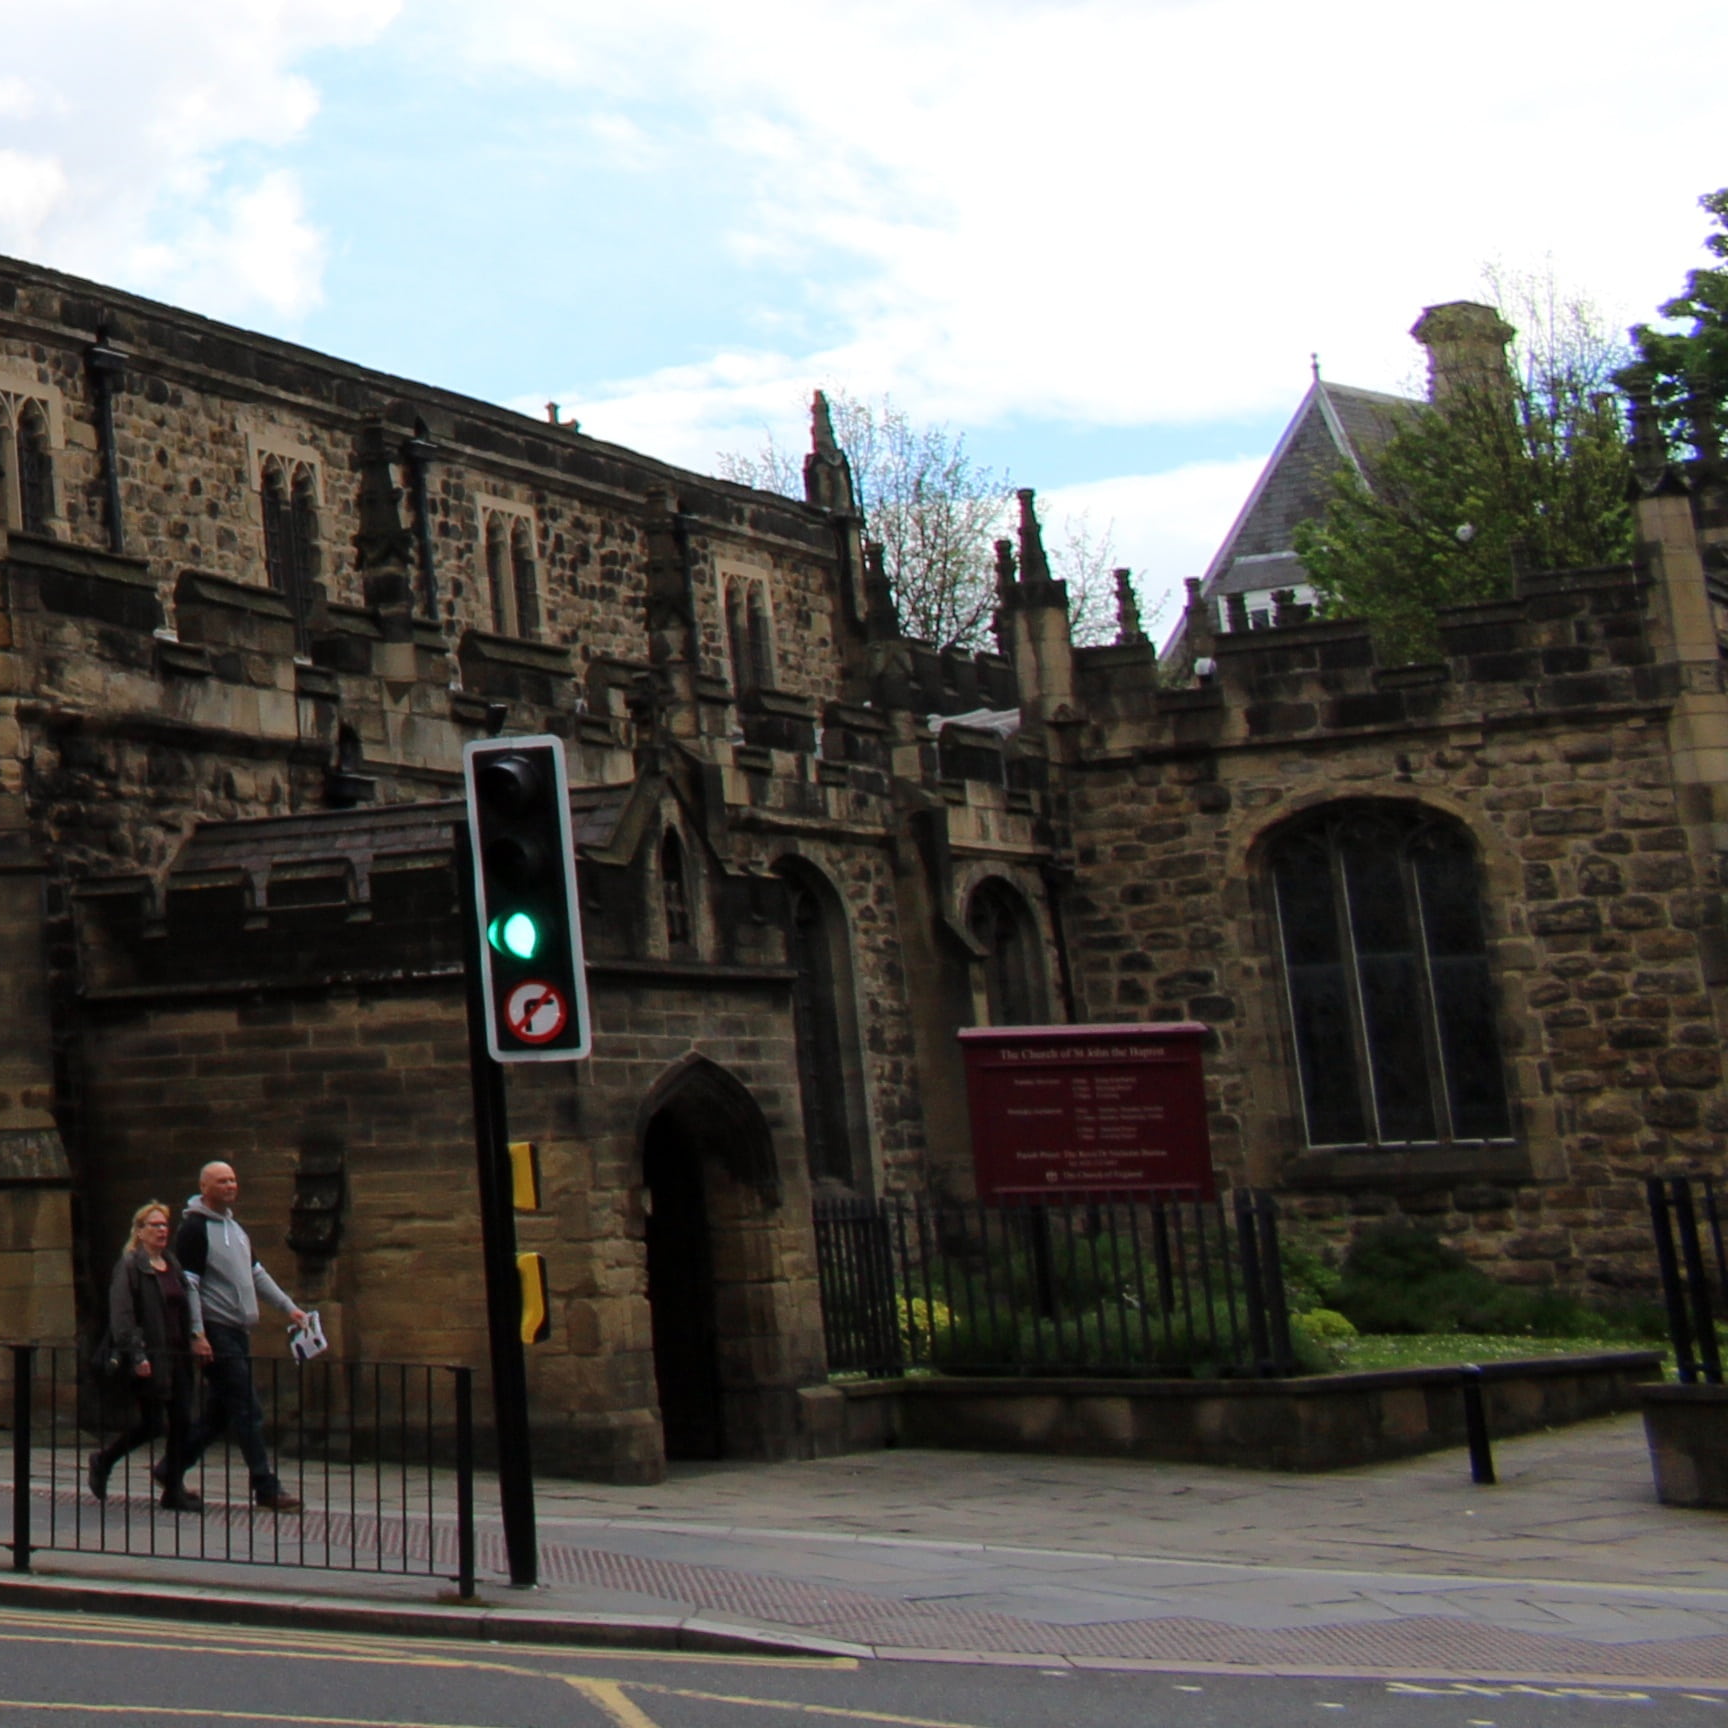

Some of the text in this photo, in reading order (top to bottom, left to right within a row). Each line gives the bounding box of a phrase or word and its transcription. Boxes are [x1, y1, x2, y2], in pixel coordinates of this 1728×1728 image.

[1000, 1049, 1018, 1060] The
[1021, 1049, 1058, 1060] Church
[1060, 1048, 1071, 1058] of
[1087, 1047, 1109, 1057] John
[1111, 1047, 1128, 1057] the
[1129, 1046, 1165, 1059] Baptist
